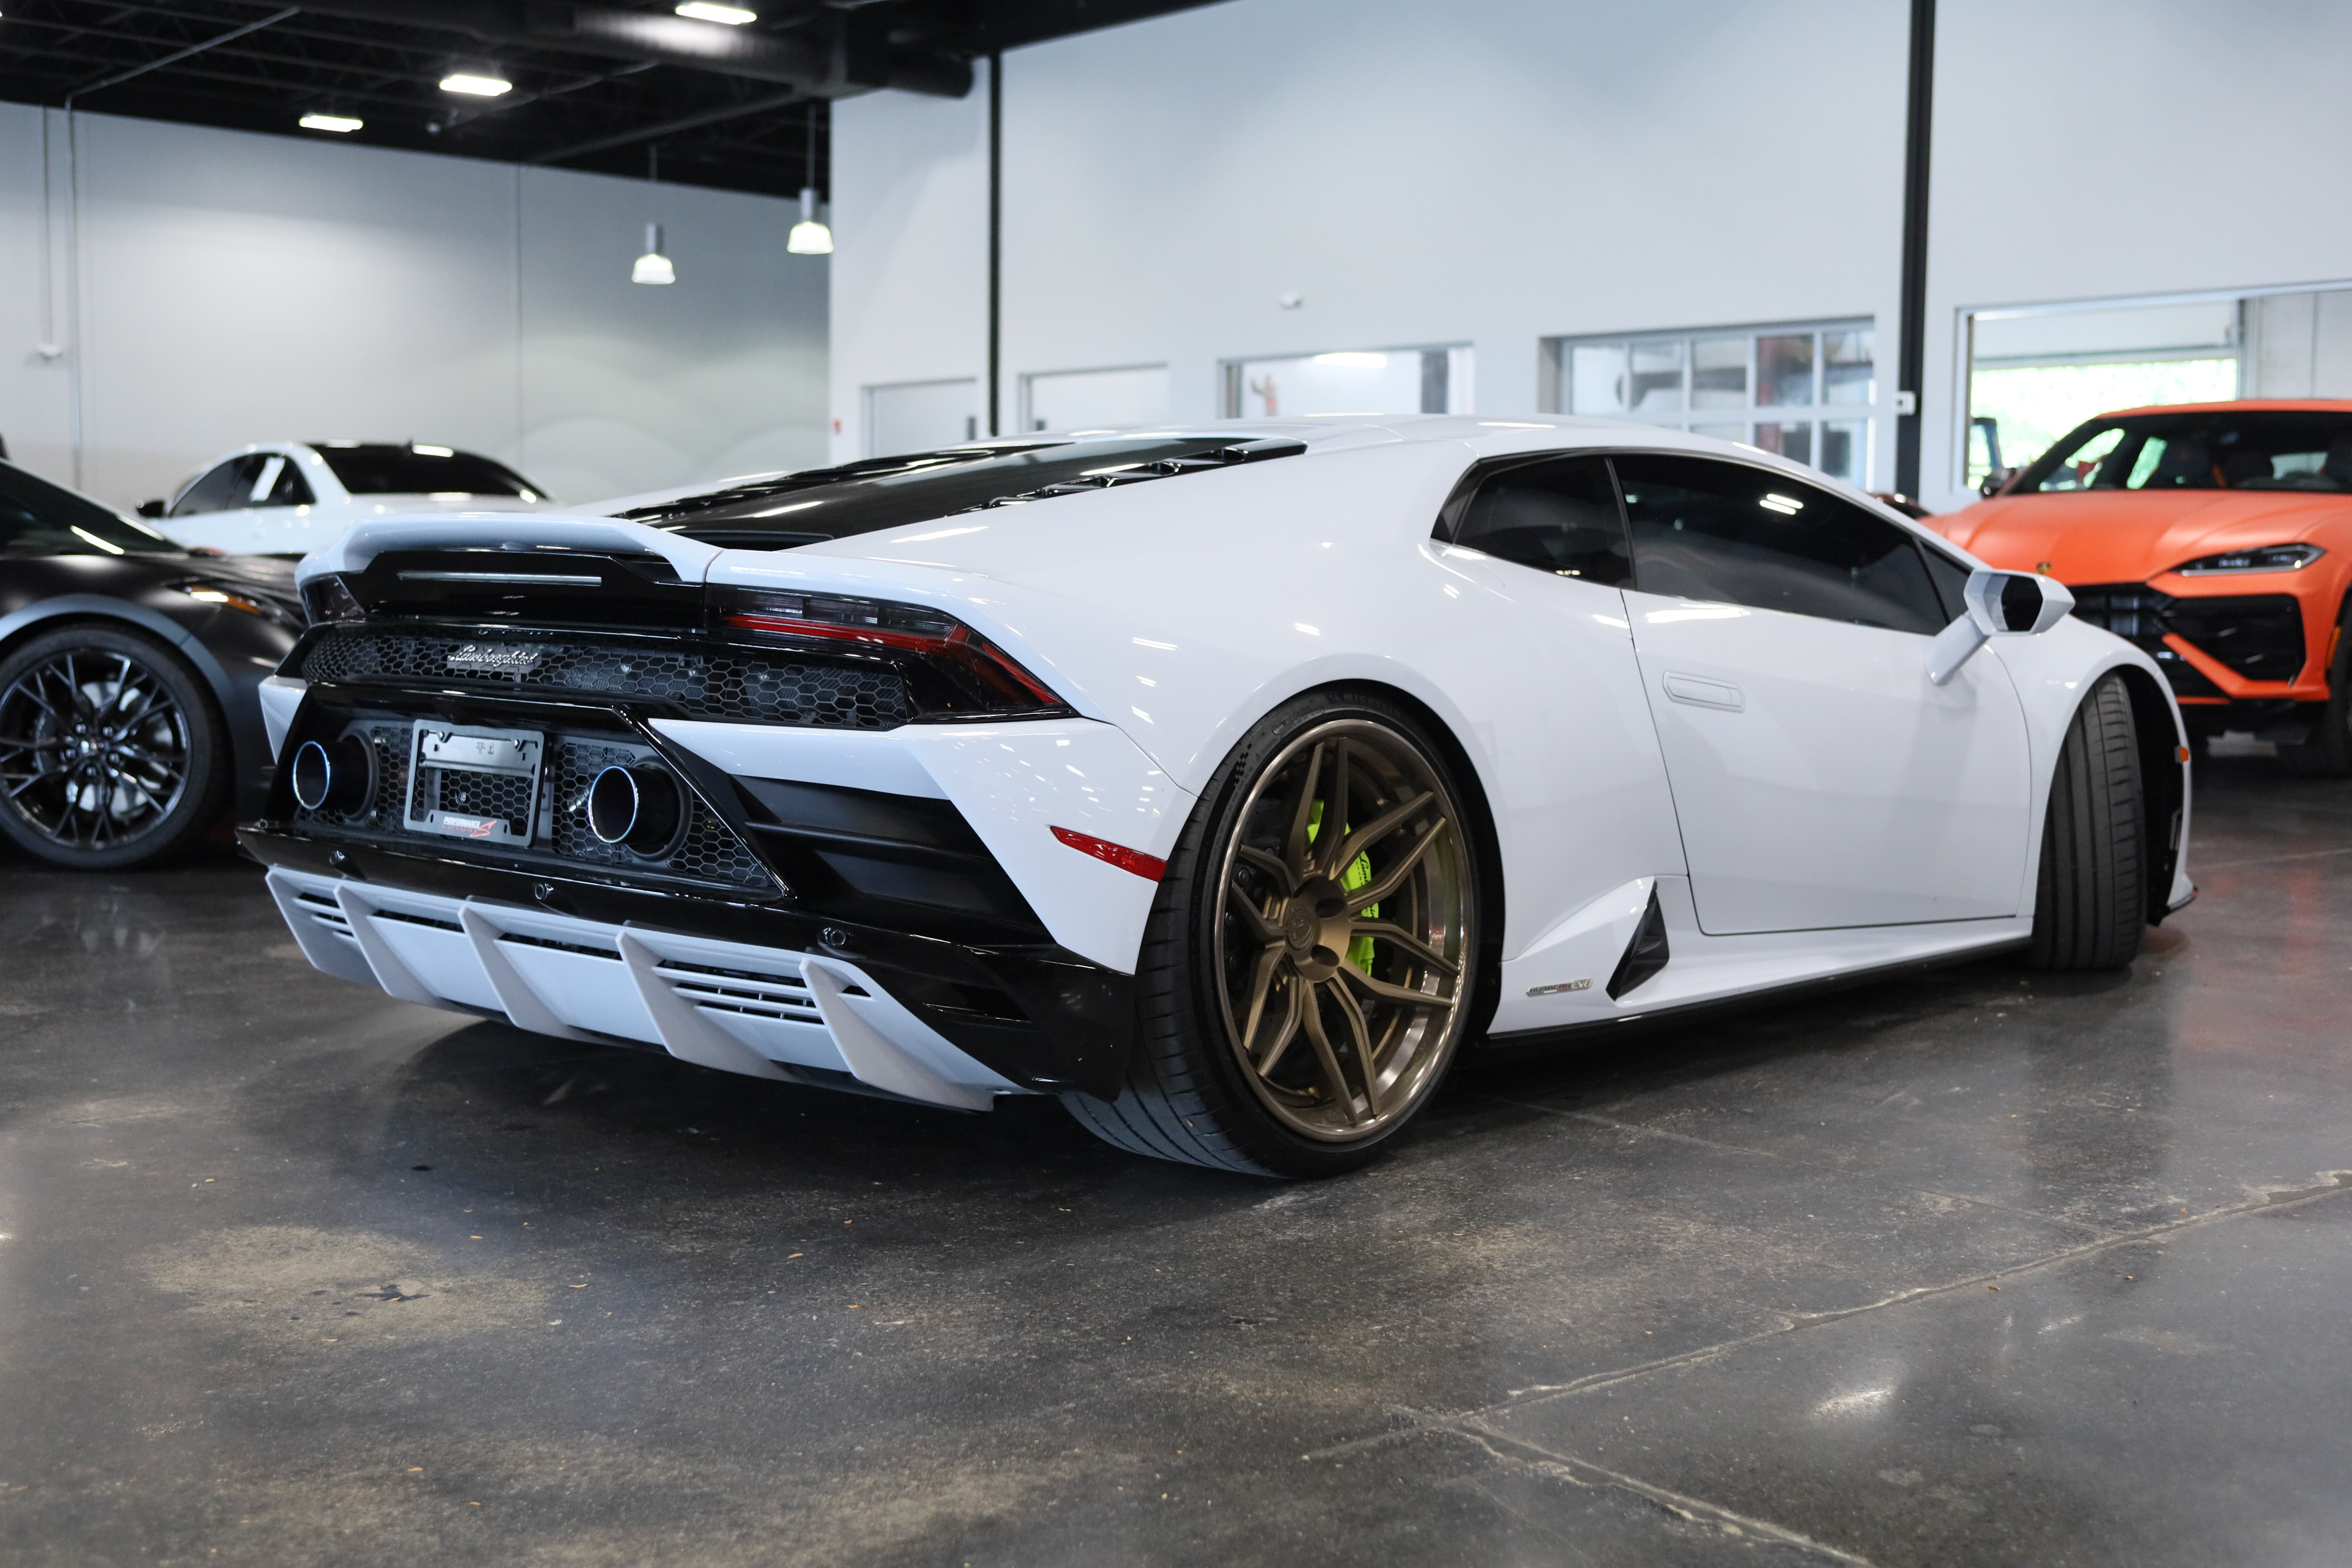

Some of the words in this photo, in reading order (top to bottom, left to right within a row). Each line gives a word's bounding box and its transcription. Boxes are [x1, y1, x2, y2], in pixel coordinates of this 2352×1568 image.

[447, 645, 539, 667] Lamborghini
[443, 817, 481, 829] PERFORMANCE
[442, 824, 479, 834] LUXURY
[1571, 980, 1592, 989] EVO
